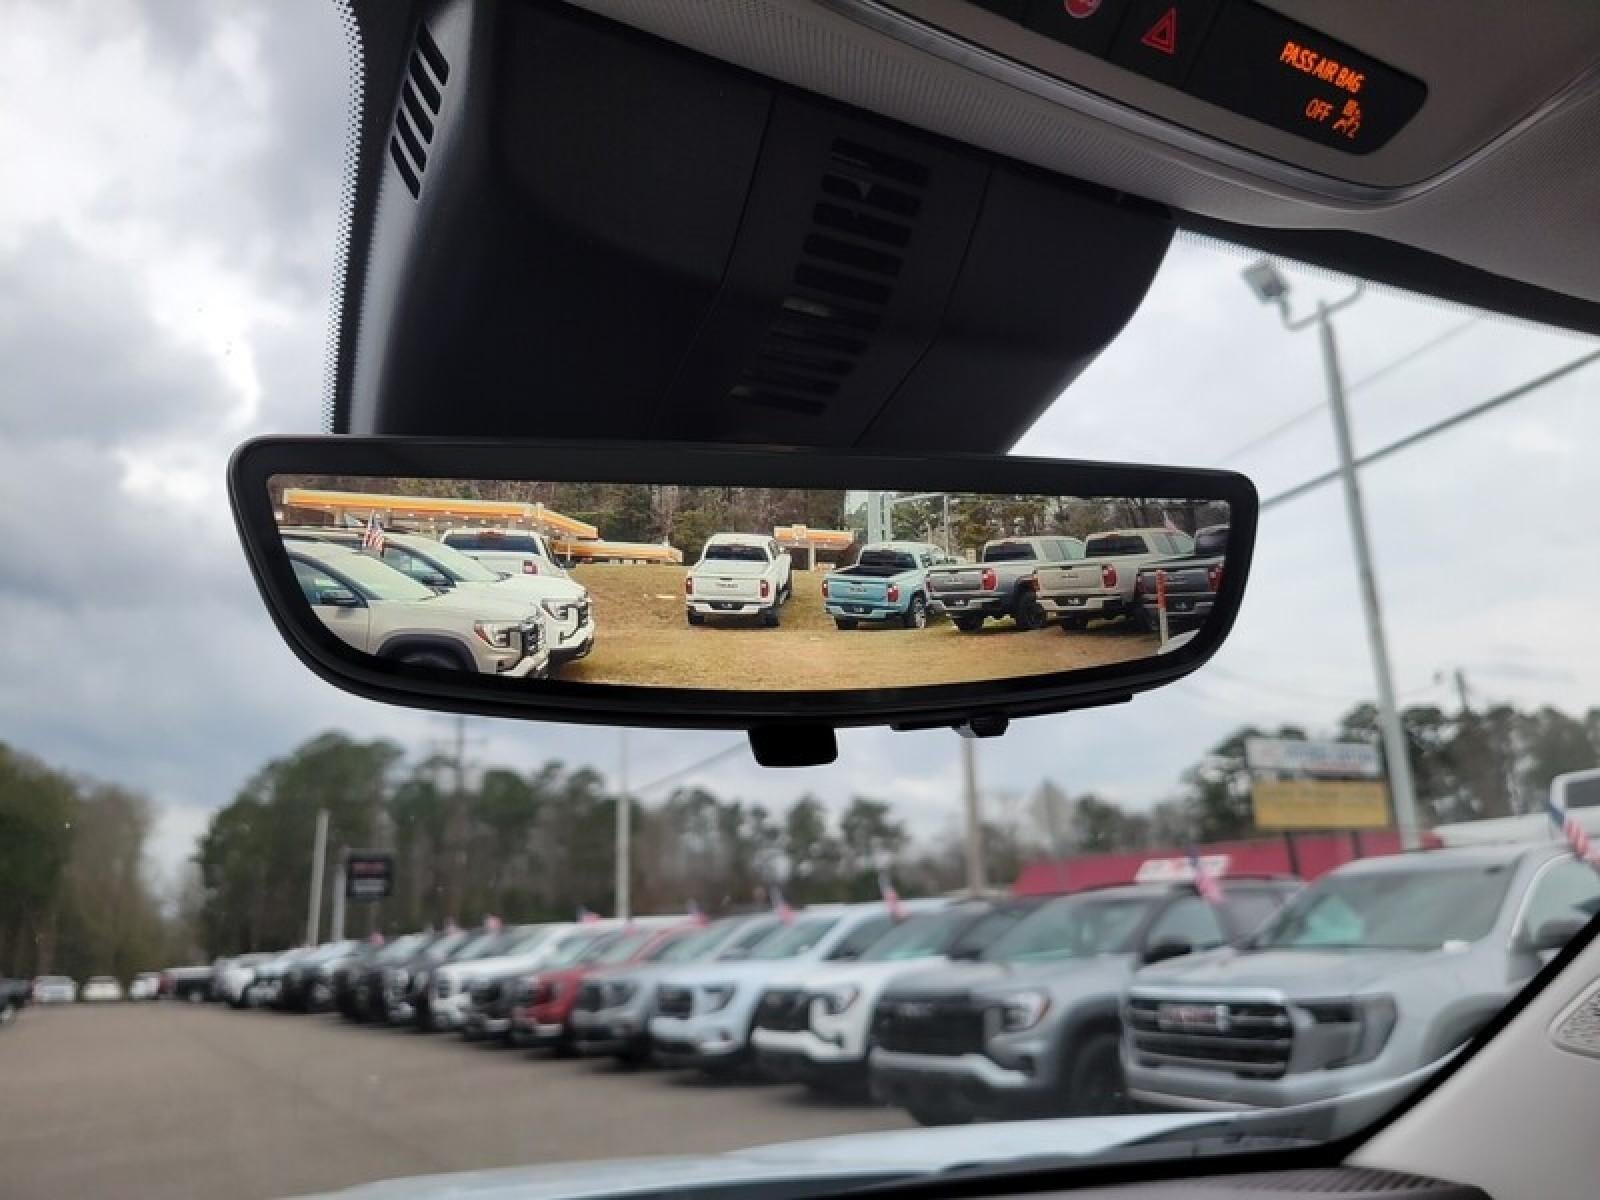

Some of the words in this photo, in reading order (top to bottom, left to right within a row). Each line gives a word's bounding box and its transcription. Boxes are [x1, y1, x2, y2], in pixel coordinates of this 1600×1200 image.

[1280, 41, 1318, 72] PASS
[1312, 57, 1339, 82] AIR
[1335, 67, 1364, 92] BAG
[1306, 99, 1333, 120] OFF
